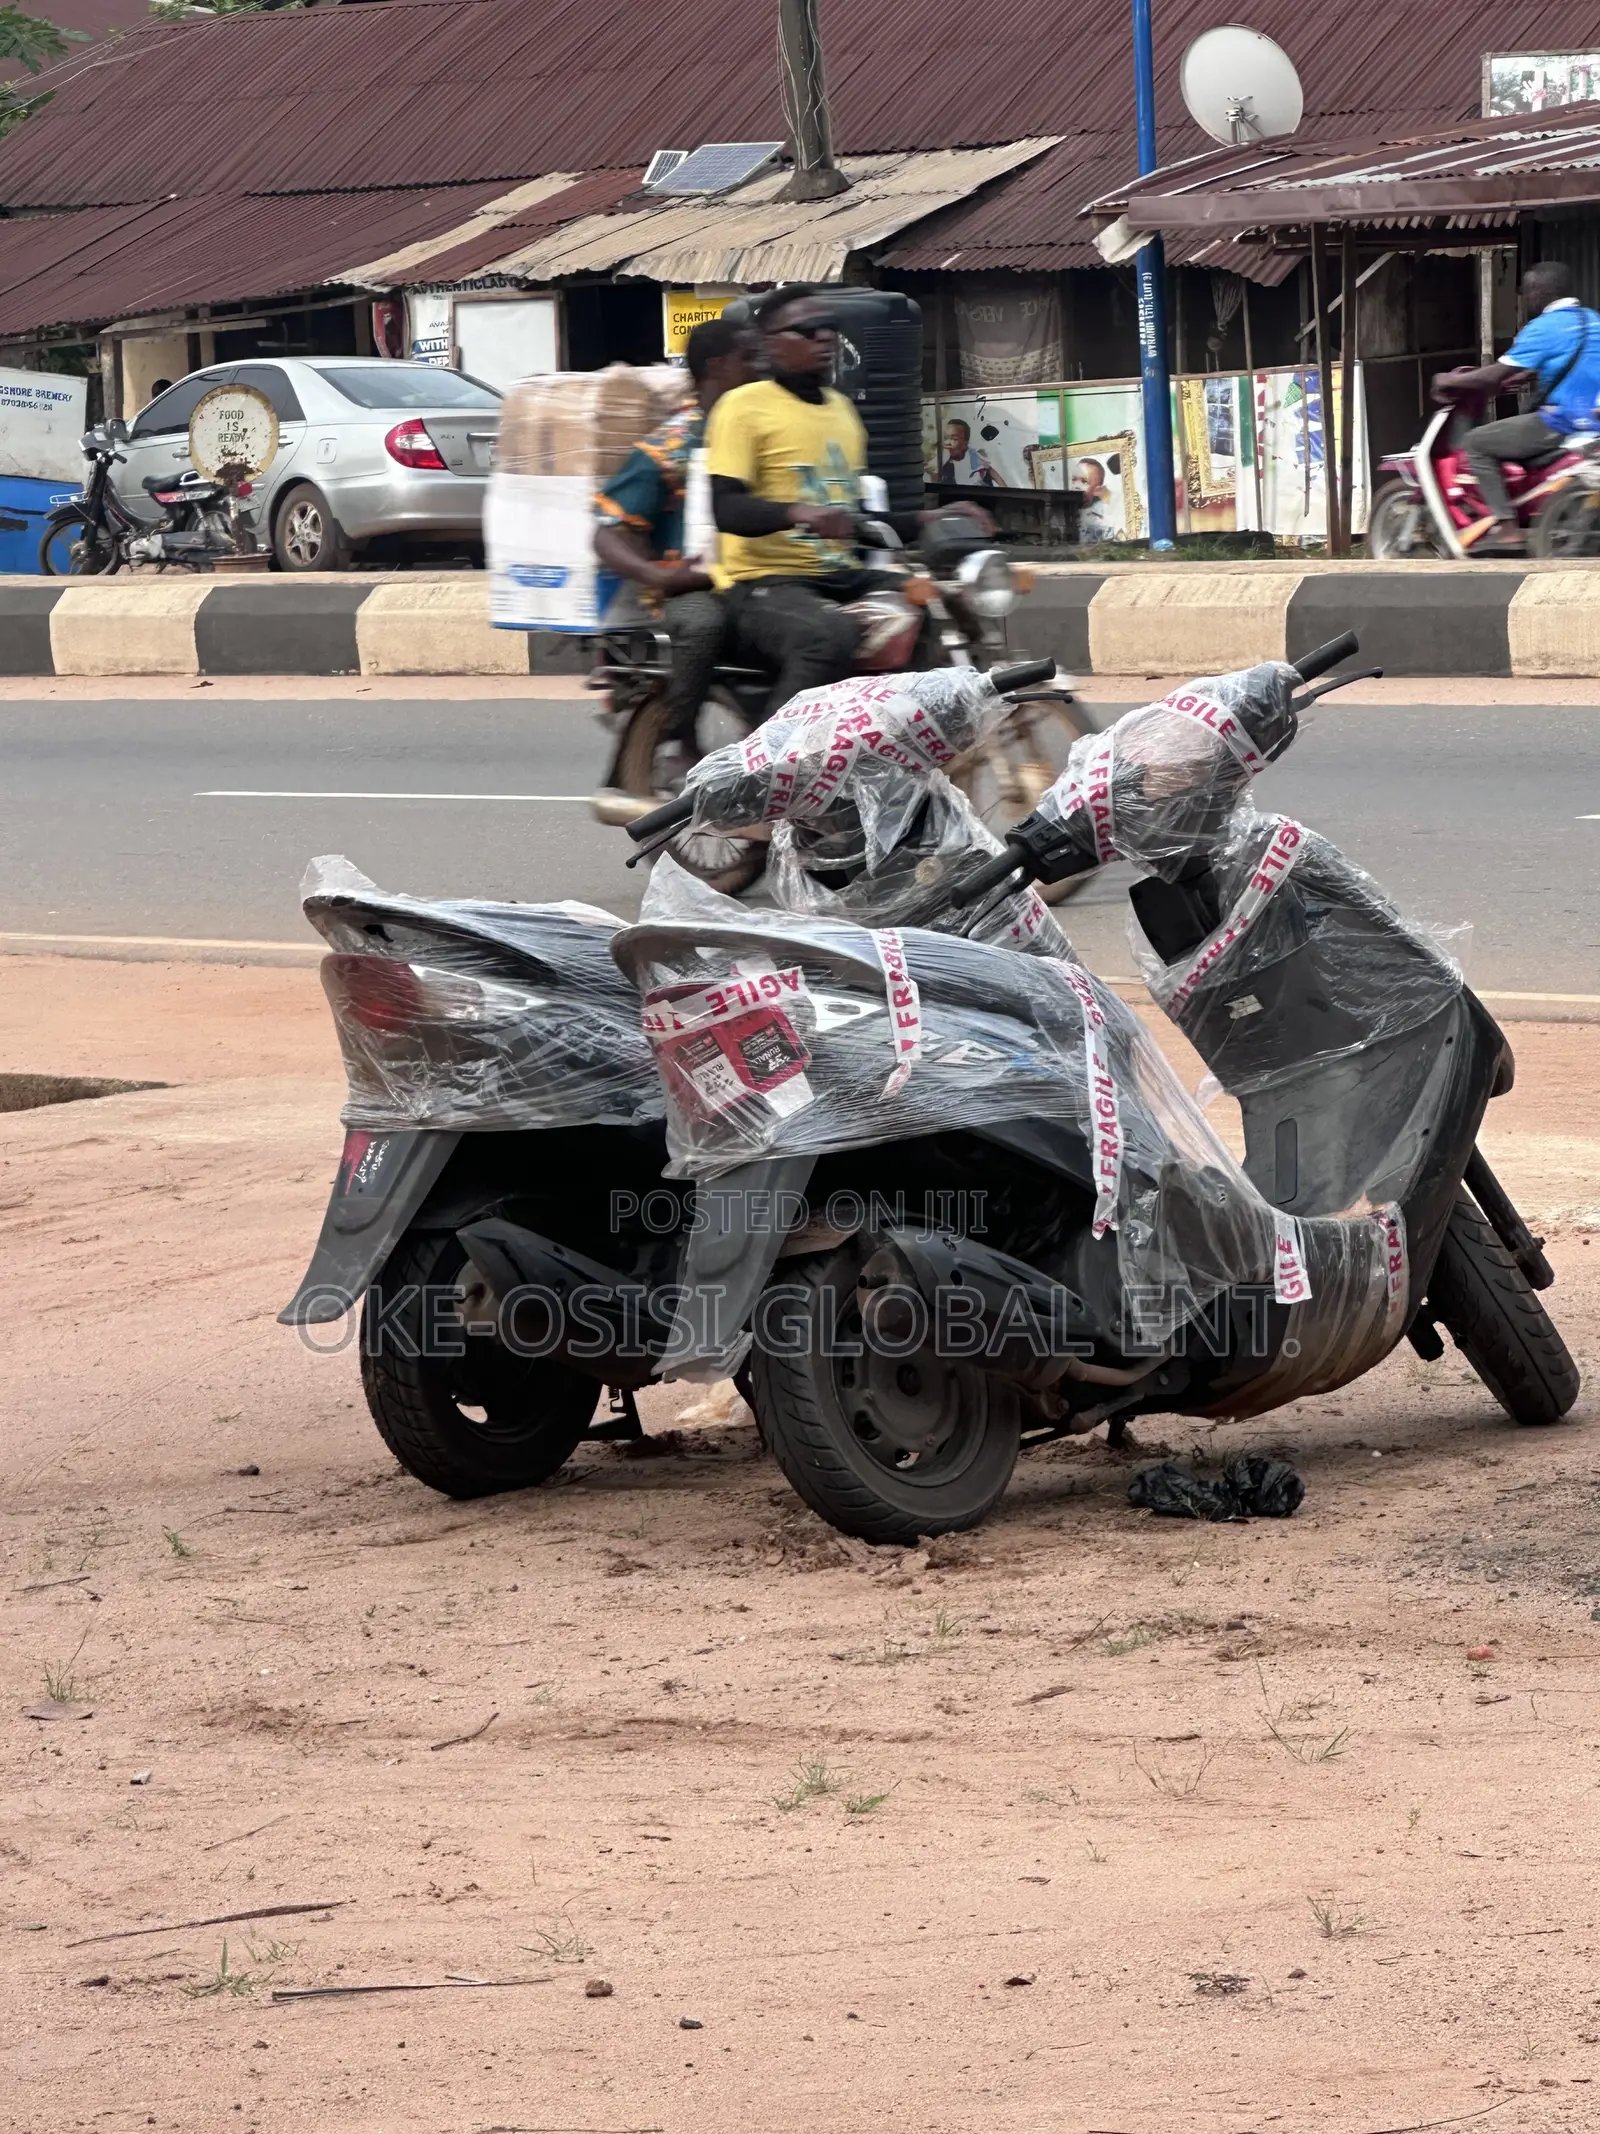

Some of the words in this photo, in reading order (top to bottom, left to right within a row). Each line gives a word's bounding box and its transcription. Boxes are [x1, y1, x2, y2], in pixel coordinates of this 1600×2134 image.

[673, 311, 717, 323] CHARITY
[419, 339, 448, 351] WITH
[219, 410, 244, 420] FOOD
[226, 421, 239, 432] IS
[218, 431, 246, 443] READY
[705, 969, 801, 1016] AGILE
